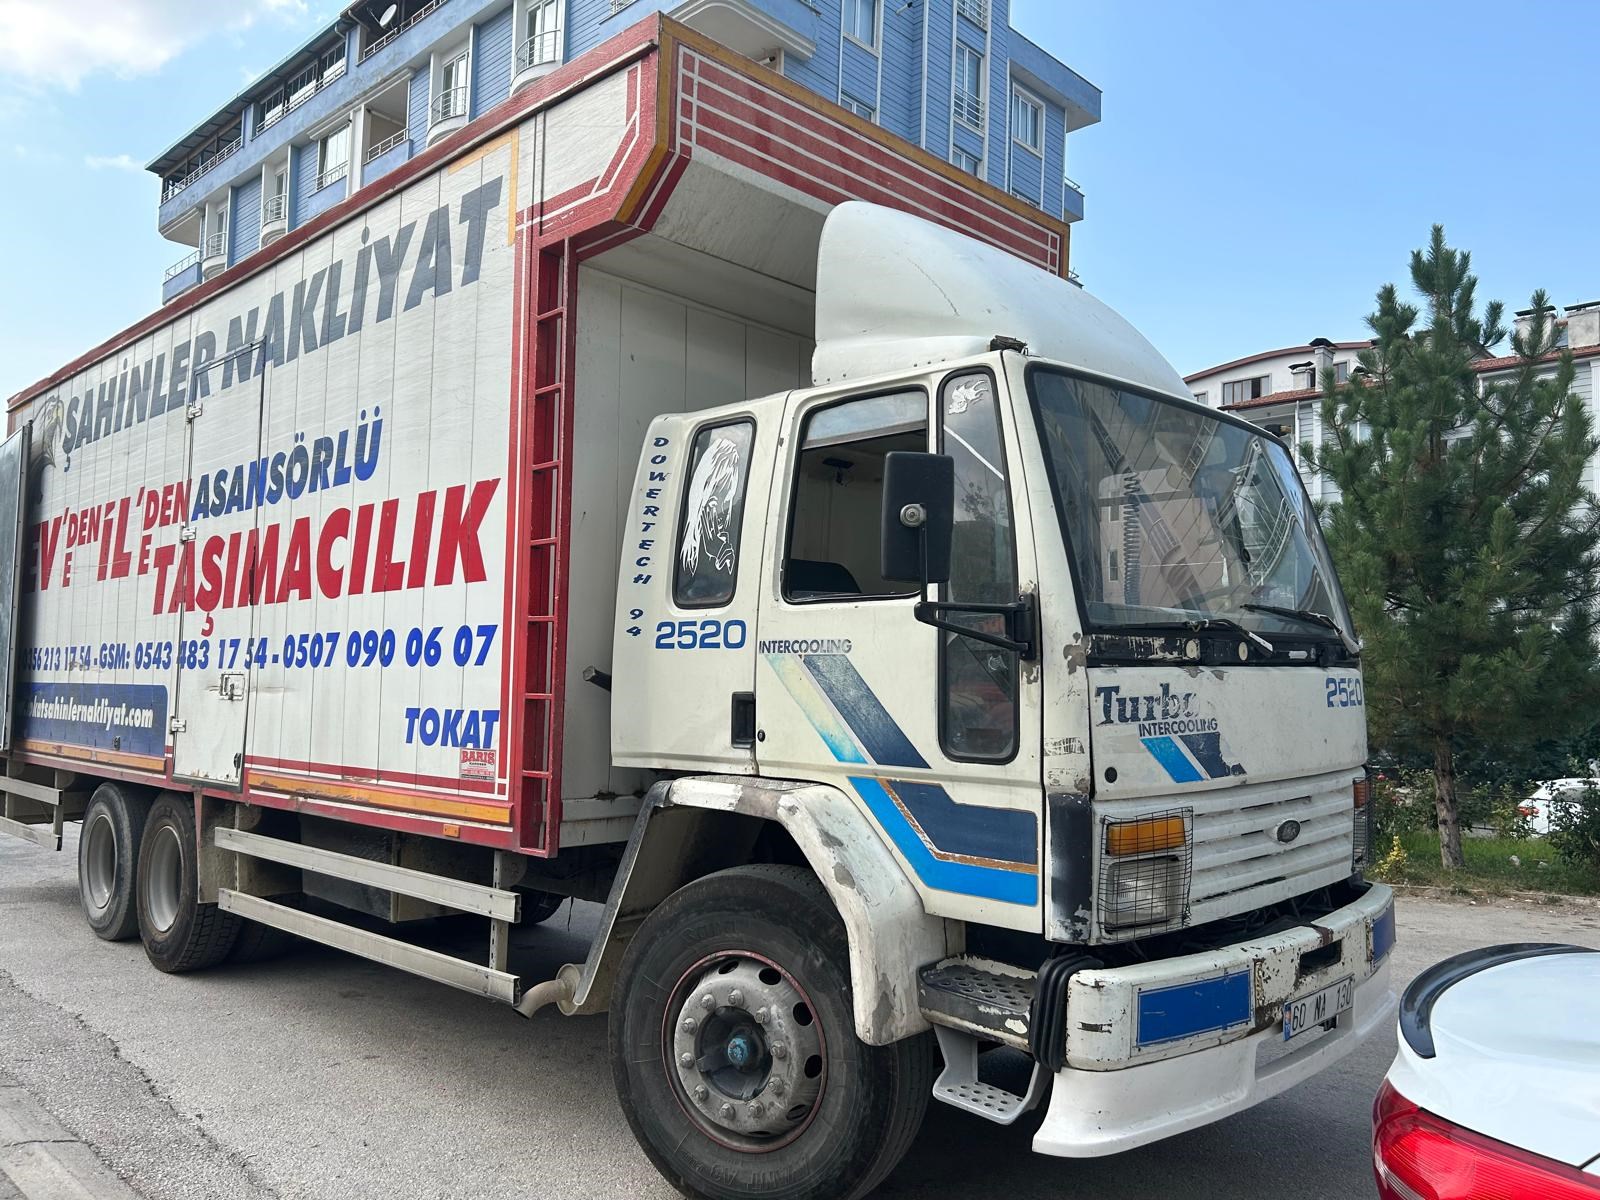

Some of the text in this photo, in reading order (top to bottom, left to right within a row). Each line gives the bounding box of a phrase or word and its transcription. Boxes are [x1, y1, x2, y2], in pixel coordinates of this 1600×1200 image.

[62, 175, 503, 473] ŞAHİNLER NAKLİYAT
[191, 405, 384, 522] ASANSÖRLÜ
[153, 477, 502, 637] TAŞIMACILIK
[626, 608, 644, 637] 94
[655, 619, 747, 650] 2520
[43, 646, 60, 671] 213
[64, 646, 77, 671] 17
[80, 645, 91, 671] 54
[100, 642, 131, 670] GSM:
[135, 641, 173, 670] 0543
[177, 639, 209, 670] 483
[218, 638, 240, 669] 17
[244, 636, 268, 670] 54
[283, 632, 341, 669] 0507
[346, 628, 396, 668] 090
[405, 626, 443, 668] 06
[453, 624, 498, 667] 07
[759, 638, 853, 654] INTERCOOLING
[1325, 677, 1363, 708] 2520
[404, 706, 500, 749] TOKAT
[1138, 718, 1218, 737] INTERCOOLING
[1292, 981, 1353, 1032] 60 NA 130
